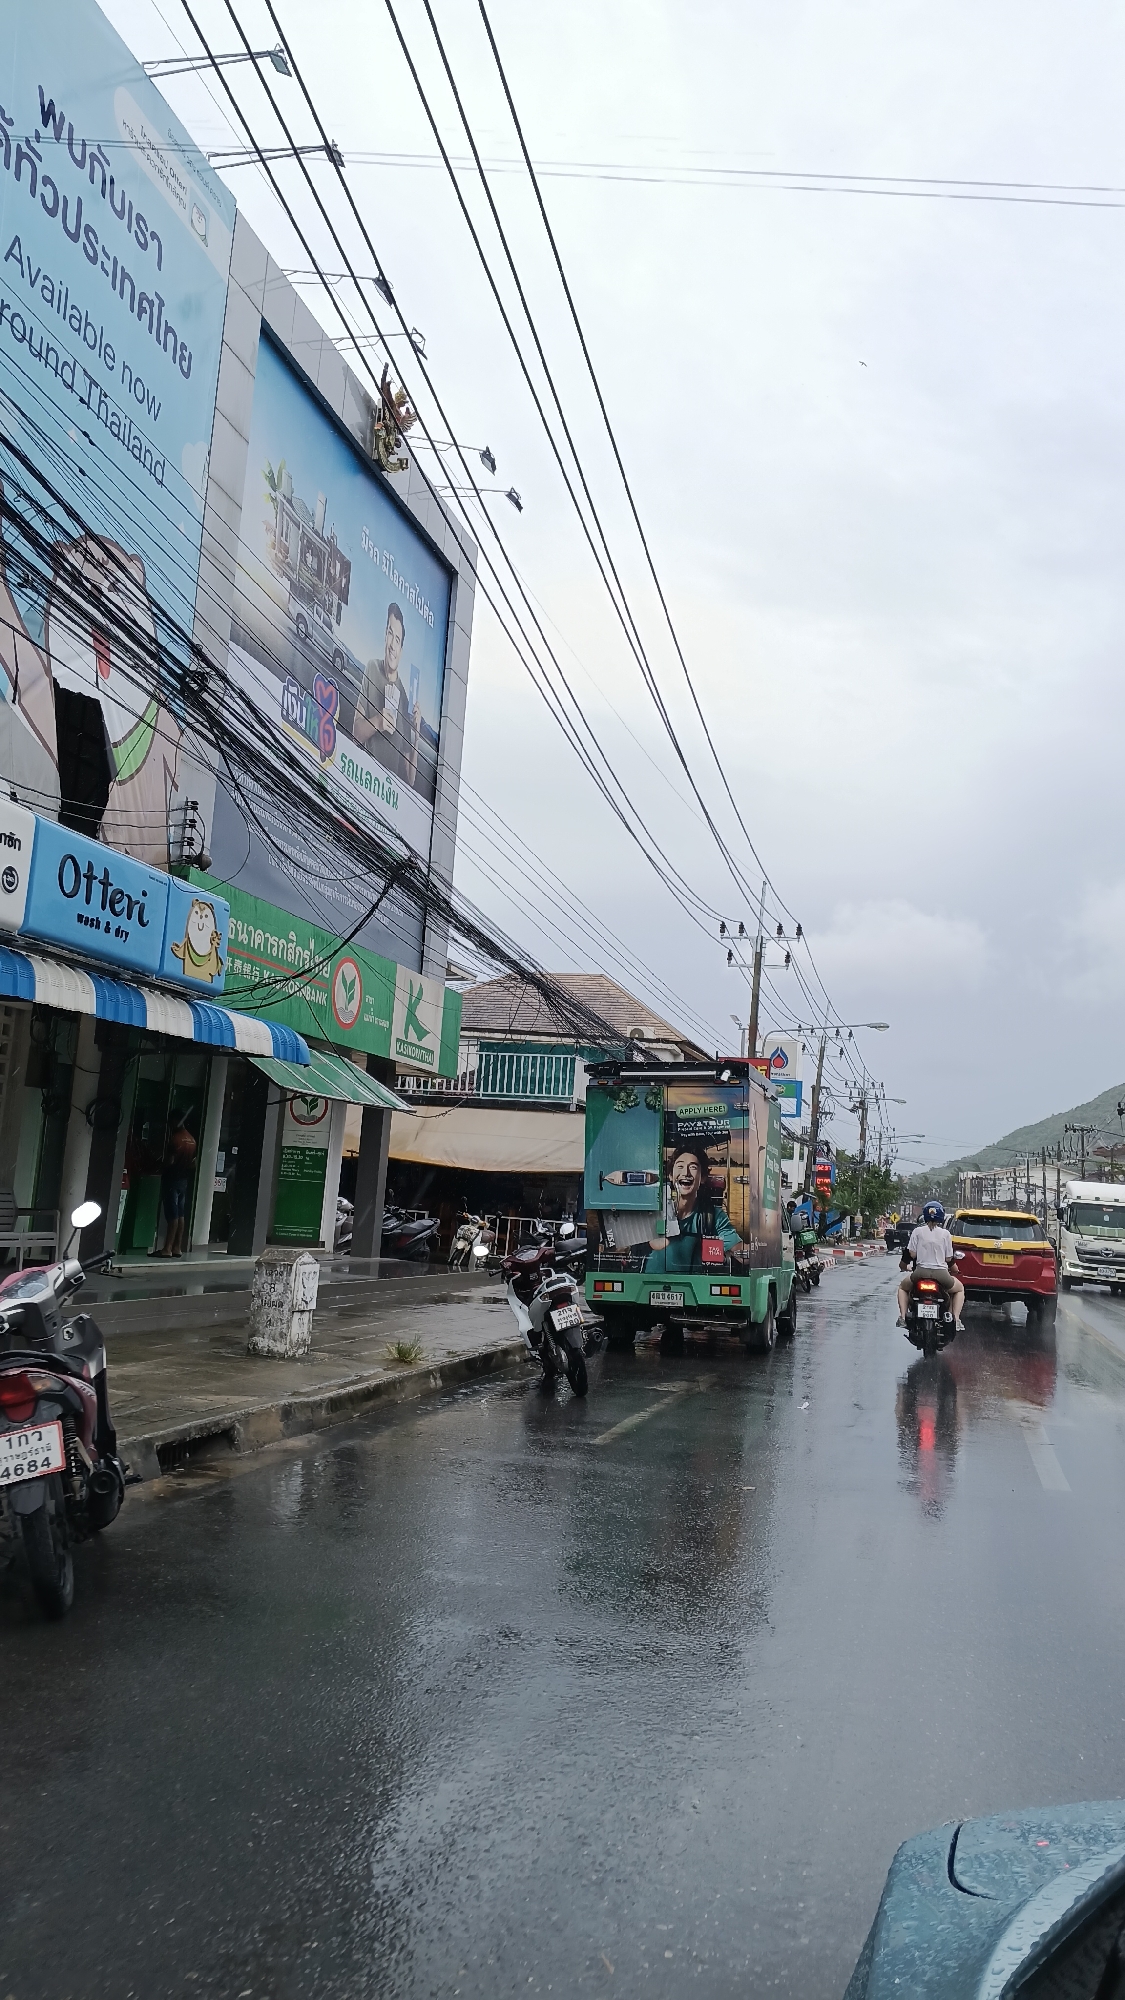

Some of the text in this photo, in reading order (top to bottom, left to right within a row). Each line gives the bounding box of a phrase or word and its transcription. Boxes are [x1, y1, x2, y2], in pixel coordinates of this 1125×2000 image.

[38, 85, 163, 271] พบกับเรา
[169, 167, 188, 193] Otteri
[4, 234, 162, 422] Available now
[83, 367, 166, 489] Thailand
[361, 525, 435, 629] มีรถ มีโอกาสไปต่อ
[340, 752, 399, 811] รถแลกเงิน
[58, 853, 150, 928] Otteri
[76, 911, 130, 943] wash & dry
[228, 917, 331, 979] ธนาคารกสิกรไทย
[396, 1041, 434, 1064] KASIKORNTHAI
[679, 1105, 726, 1115] APPLY HERE!
[606, 1228, 615, 1248] VISA
[666, 1293, 683, 1301] 4617
[0, 1442, 52, 1466] ราษฎร์ธานี
[0, 1456, 52, 1480] 4684
